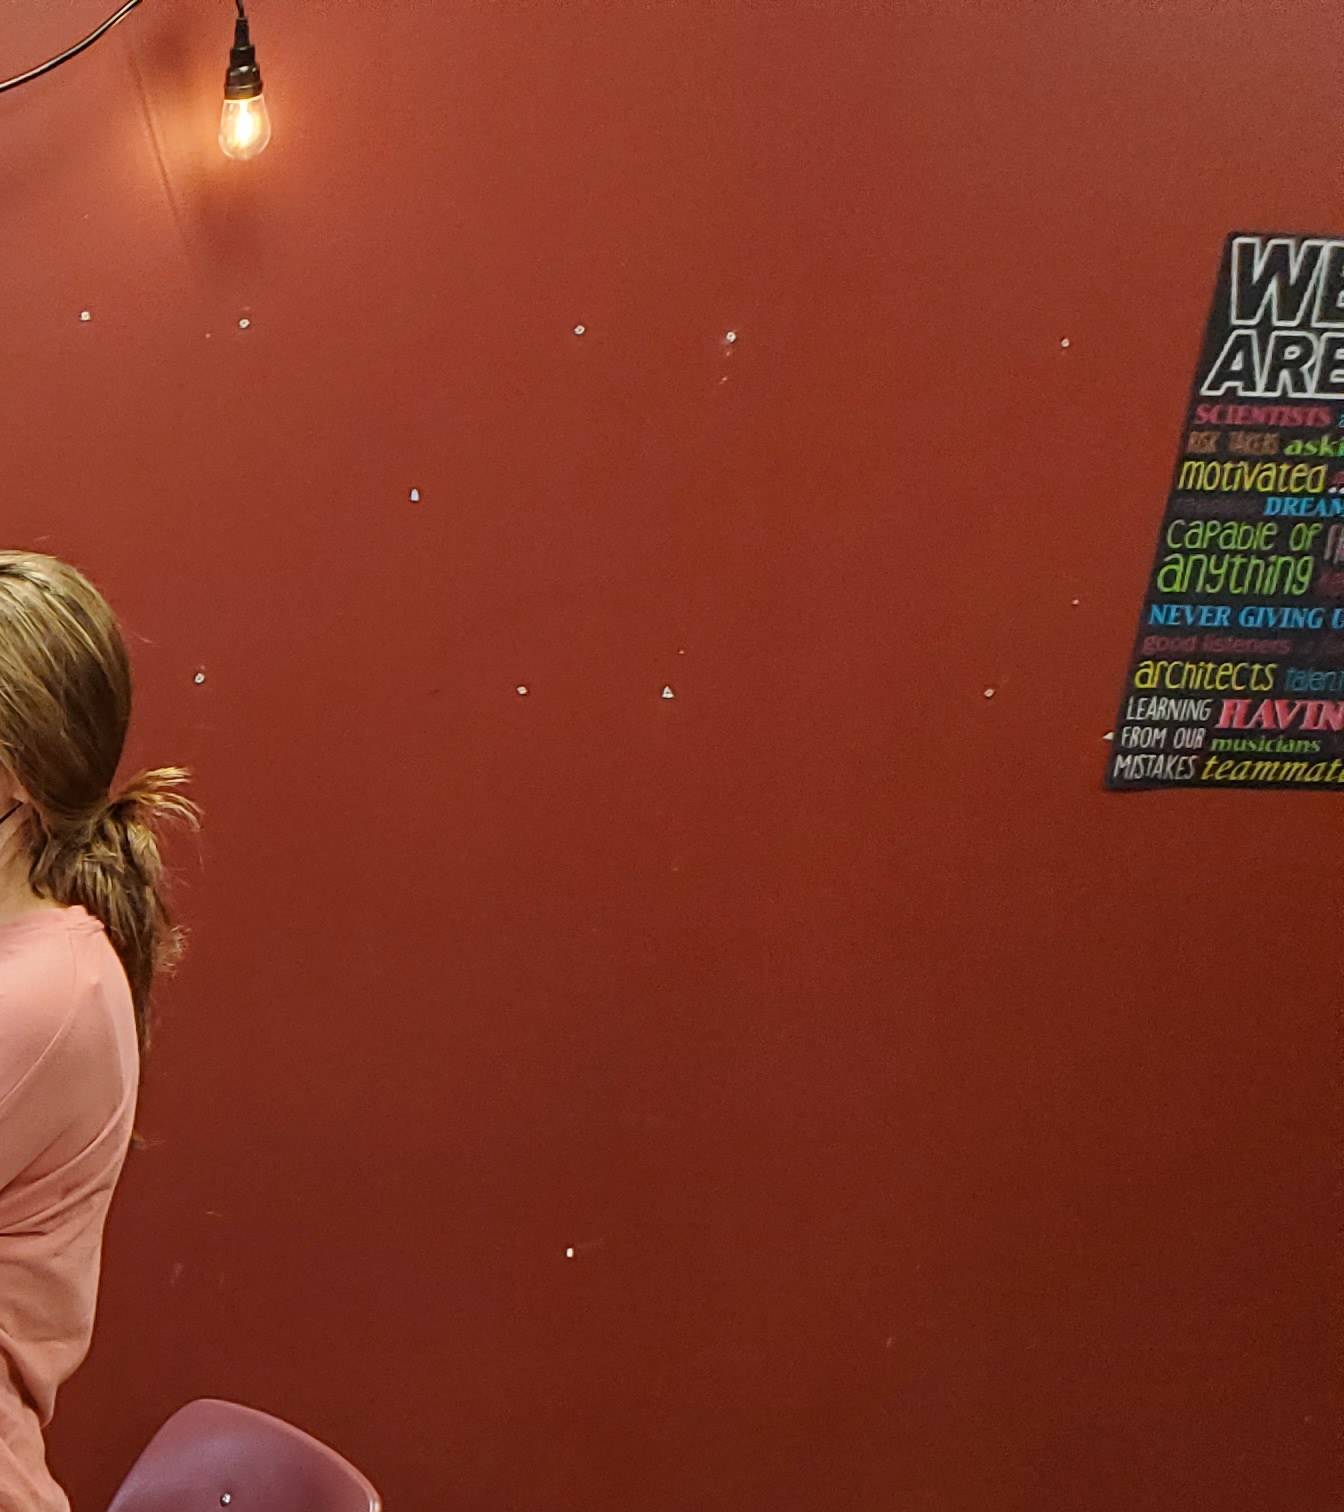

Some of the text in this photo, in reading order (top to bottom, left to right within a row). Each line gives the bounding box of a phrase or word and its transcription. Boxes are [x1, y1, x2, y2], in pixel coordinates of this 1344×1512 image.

[1199, 328, 1344, 399] ARE
[1177, 460, 1329, 494] motivated
[1166, 518, 1279, 551] capable
[1289, 522, 1324, 552] of
[1156, 552, 1315, 596] anything
[1147, 603, 1233, 627] NEVER
[1238, 606, 1324, 629] GIVING
[1134, 659, 1279, 691] architects
[1125, 695, 1213, 722] LEARNING
[1121, 726, 1206, 750] FROM OUR
[1113, 753, 1200, 780] MISTAKES
